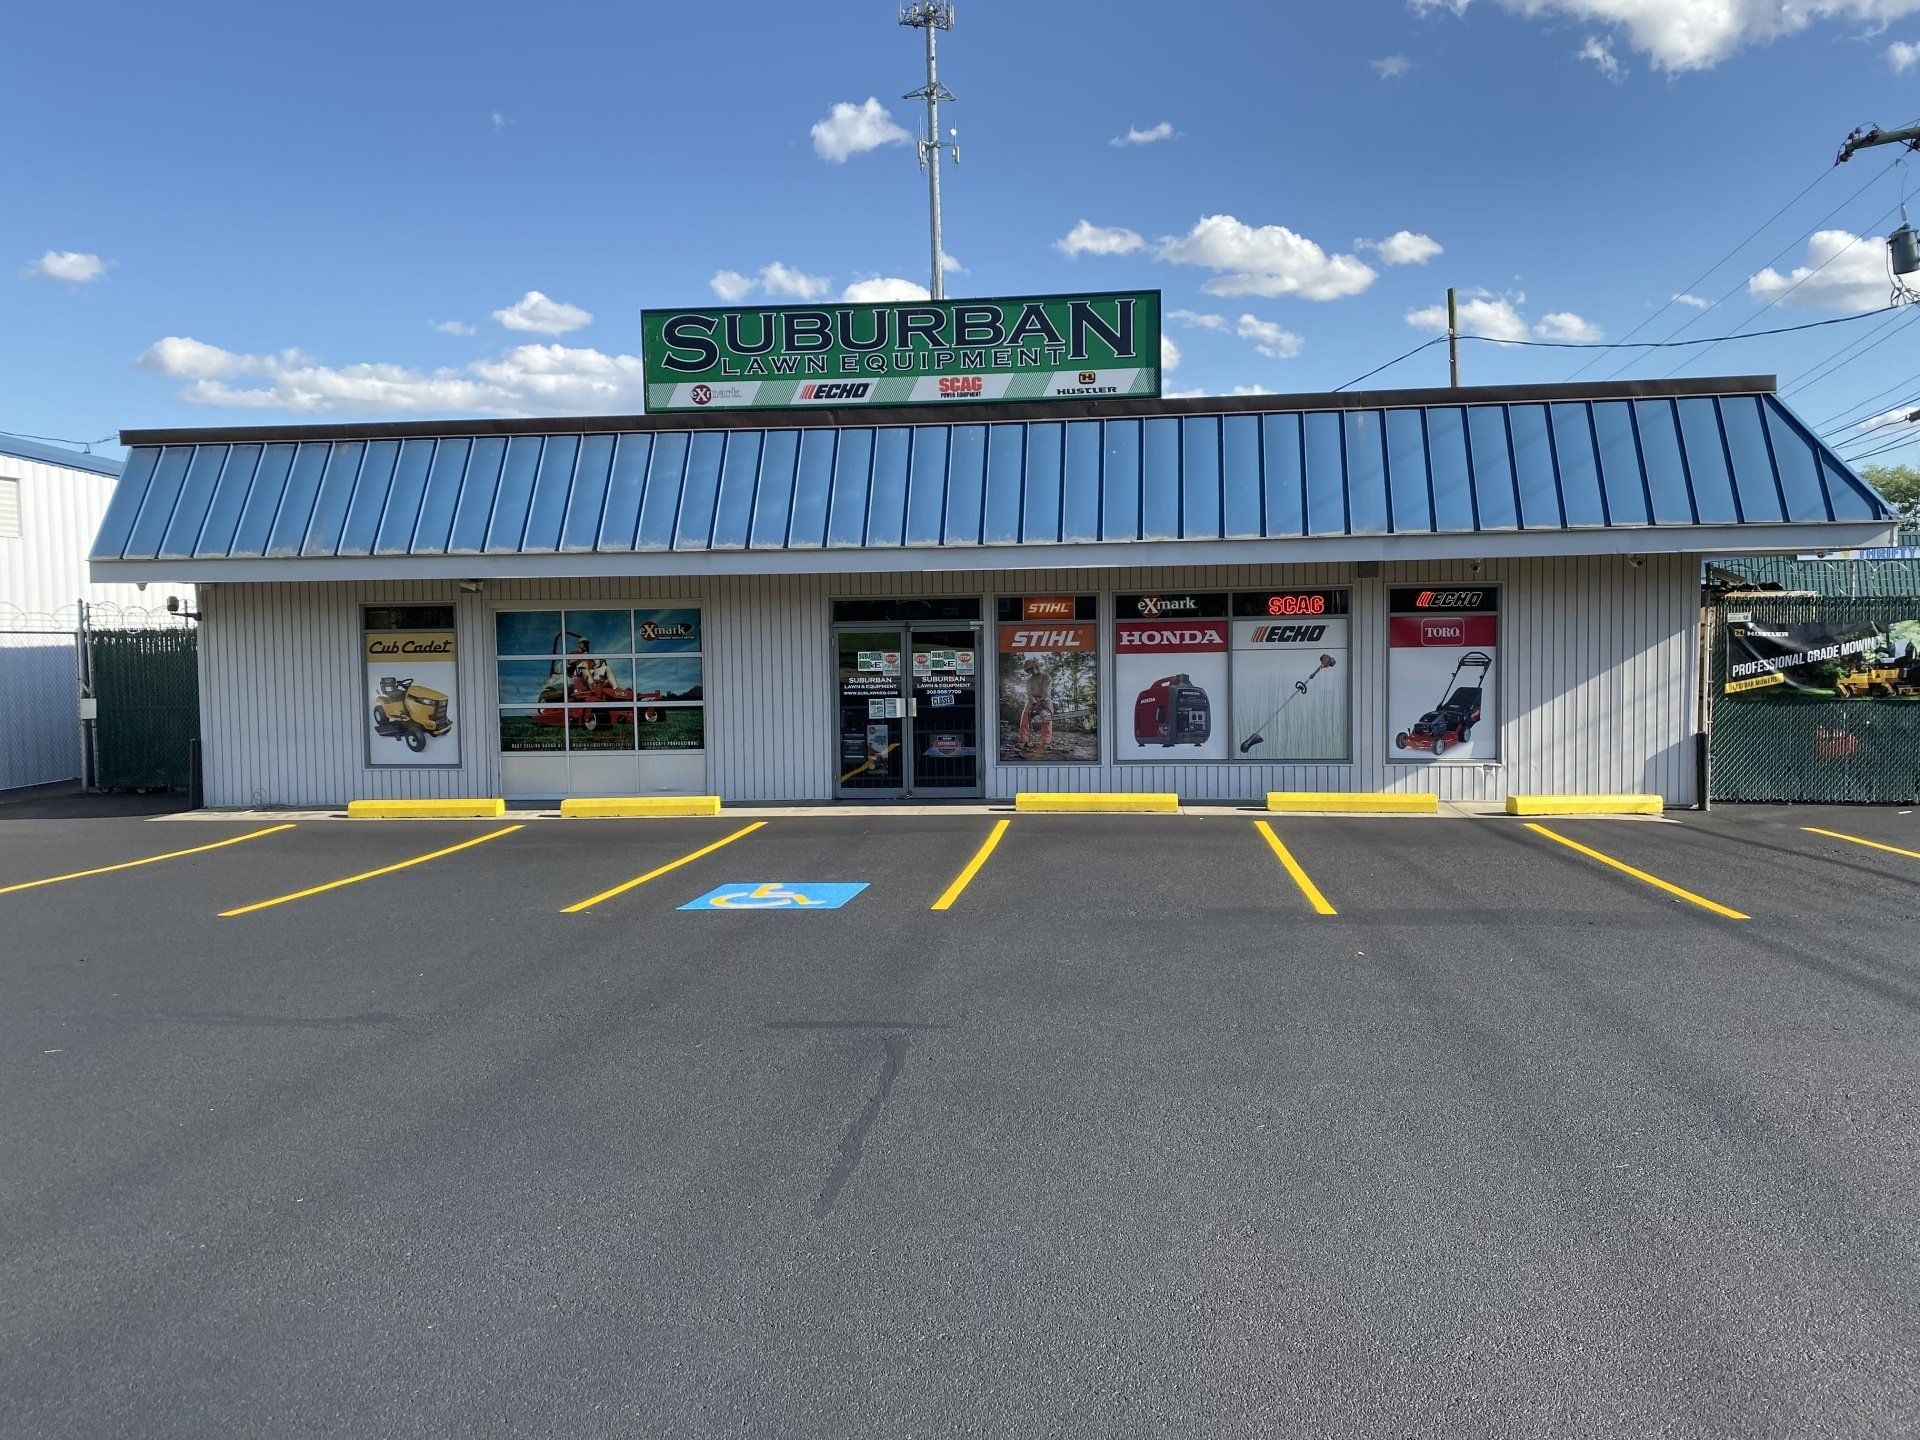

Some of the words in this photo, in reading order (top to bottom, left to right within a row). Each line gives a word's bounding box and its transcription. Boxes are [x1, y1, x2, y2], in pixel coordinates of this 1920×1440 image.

[661, 299, 1136, 373] SUBURBAN
[721, 355, 828, 376] LAWN
[840, 346, 1066, 374] EQUIPMENT
[813, 383, 870, 399] ECHO
[939, 376, 983, 392] SCAG
[1056, 386, 1118, 395] HUSTLER
[1860, 546, 1919, 559] THRIFTY
[1138, 597, 1196, 614] eXmark
[1268, 596, 1325, 615] SCAG
[1430, 592, 1484, 607] ECHO
[1027, 603, 1070, 613] STIHL
[639, 624, 686, 639] eXmark
[1011, 631, 1081, 647] STIHL
[1119, 630, 1223, 645] HONDA
[1265, 625, 1327, 642] ECHO
[1424, 627, 1461, 638] TORO
[369, 641, 400, 654] Cub
[402, 640, 453, 654] Cadet
[1732, 654, 1806, 677] PROFESSIONAL
[1807, 644, 1840, 663] GRADE
[932, 695, 954, 705] CLOSED
